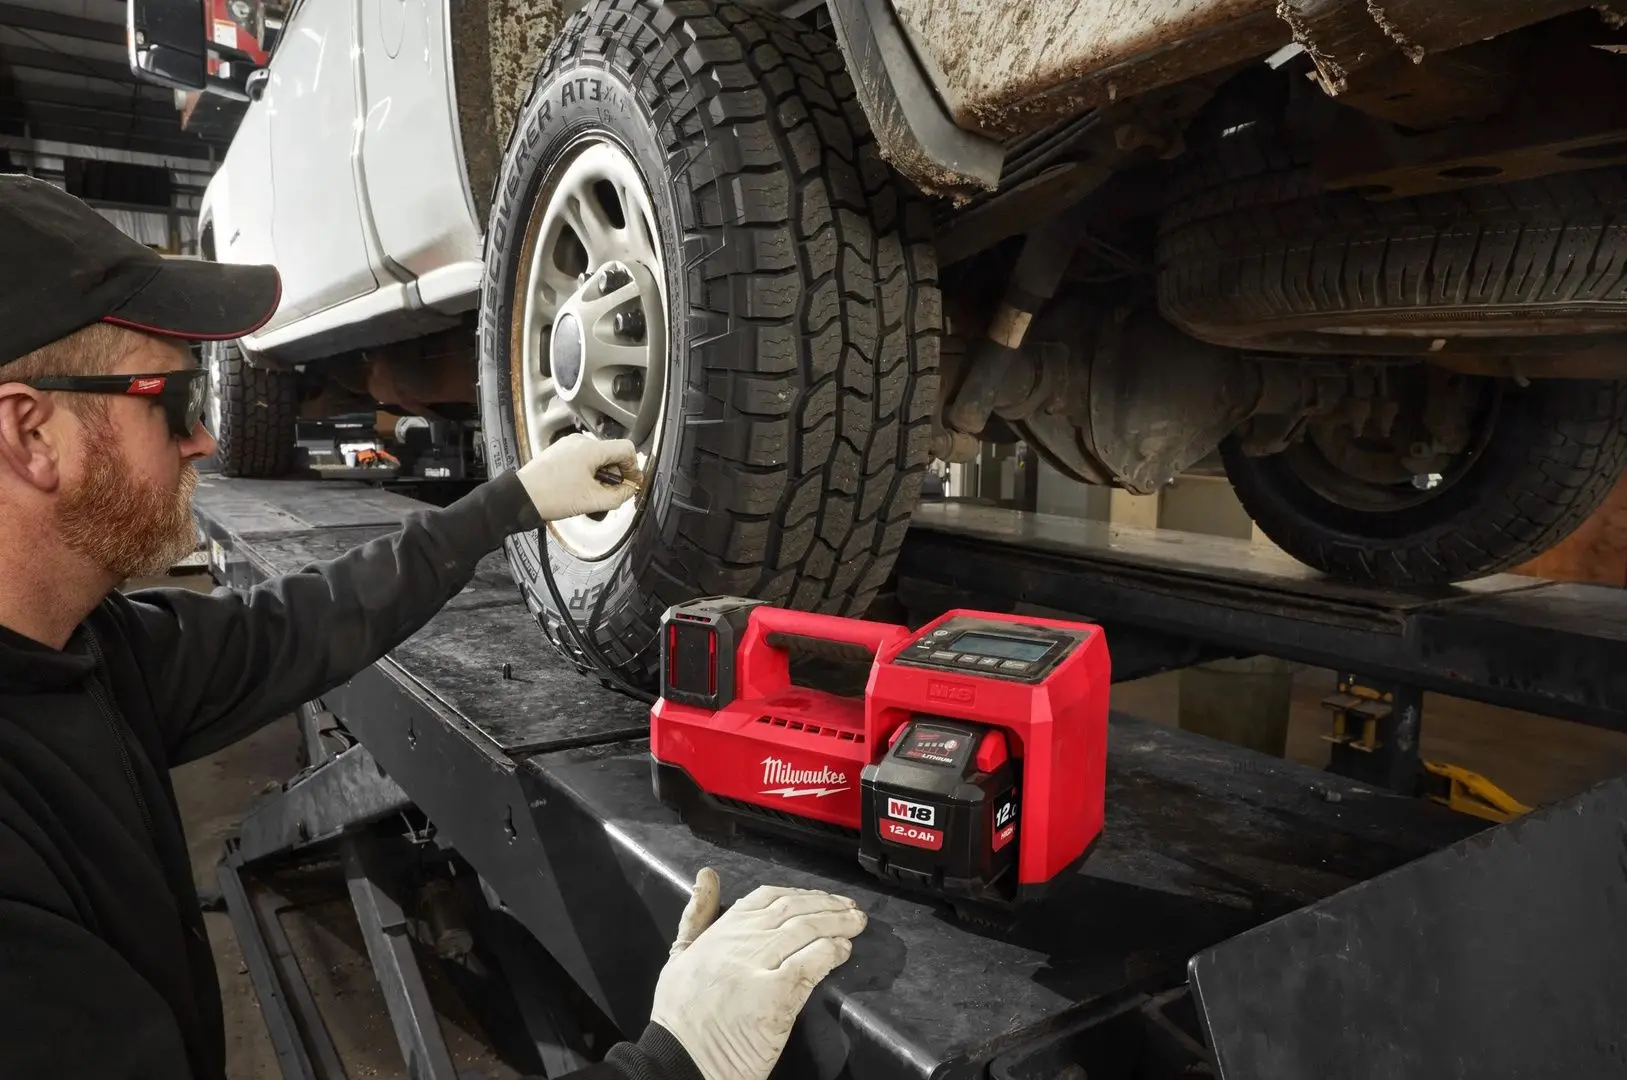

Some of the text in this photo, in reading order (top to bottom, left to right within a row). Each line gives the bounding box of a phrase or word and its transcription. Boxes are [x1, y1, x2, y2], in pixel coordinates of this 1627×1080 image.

[484, 101, 554, 361] DISCOVERER
[561, 77, 602, 107] AT3
[929, 683, 973, 702] M18
[760, 756, 847, 785] Milwaukee
[890, 801, 932, 822] M18
